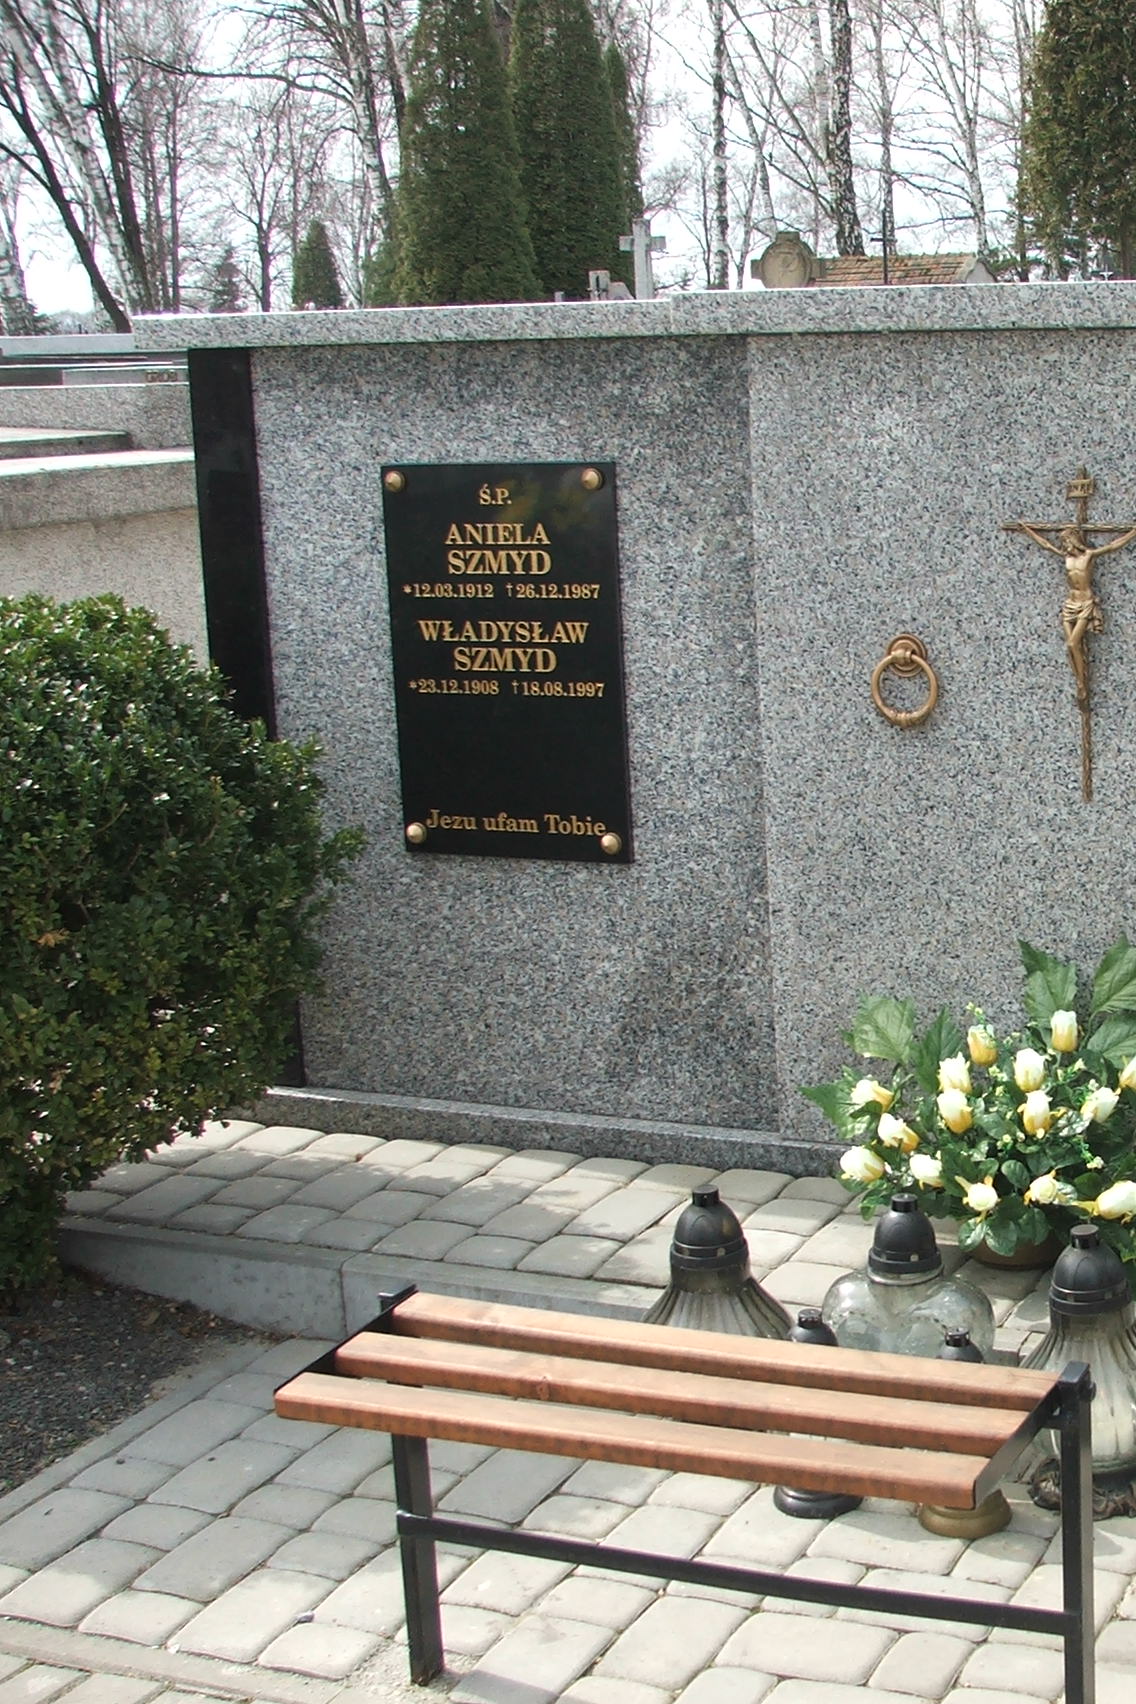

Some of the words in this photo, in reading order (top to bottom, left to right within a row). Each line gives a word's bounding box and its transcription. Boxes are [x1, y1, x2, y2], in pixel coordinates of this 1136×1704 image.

[479, 483, 513, 505] Ś.P.
[444, 522, 551, 545] ANIELA
[447, 549, 552, 575] SZMYD
[417, 619, 589, 644] WŁADYSŁAW
[453, 646, 557, 673] SZMYD
[426, 809, 477, 831] Jezu
[482, 812, 540, 833] ufam
[544, 814, 606, 836] Tobie
